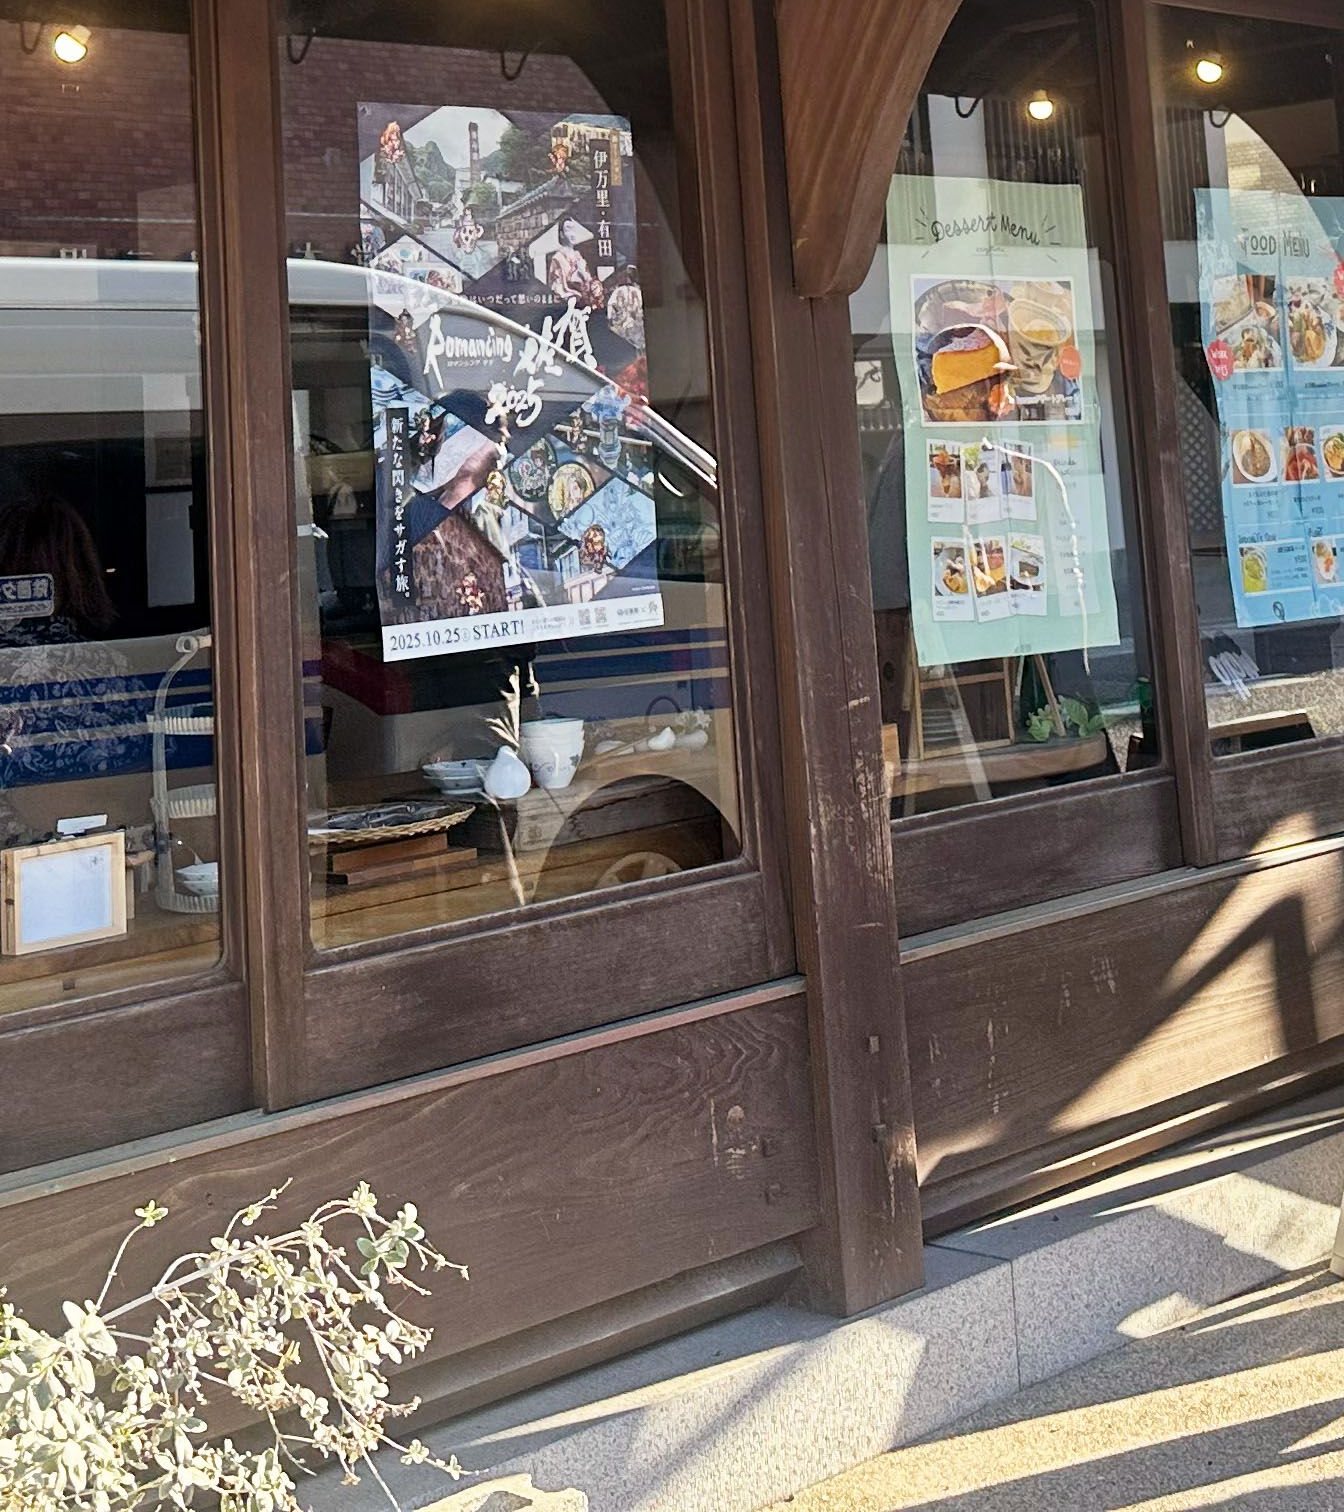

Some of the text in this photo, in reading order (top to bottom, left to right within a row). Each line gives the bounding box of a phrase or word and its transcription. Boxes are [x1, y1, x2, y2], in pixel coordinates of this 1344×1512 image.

[593, 150, 613, 257] 伊万里・有田
[931, 211, 1041, 246] Dessert Menu
[423, 313, 513, 389] Romancing
[484, 375, 545, 428] 2025
